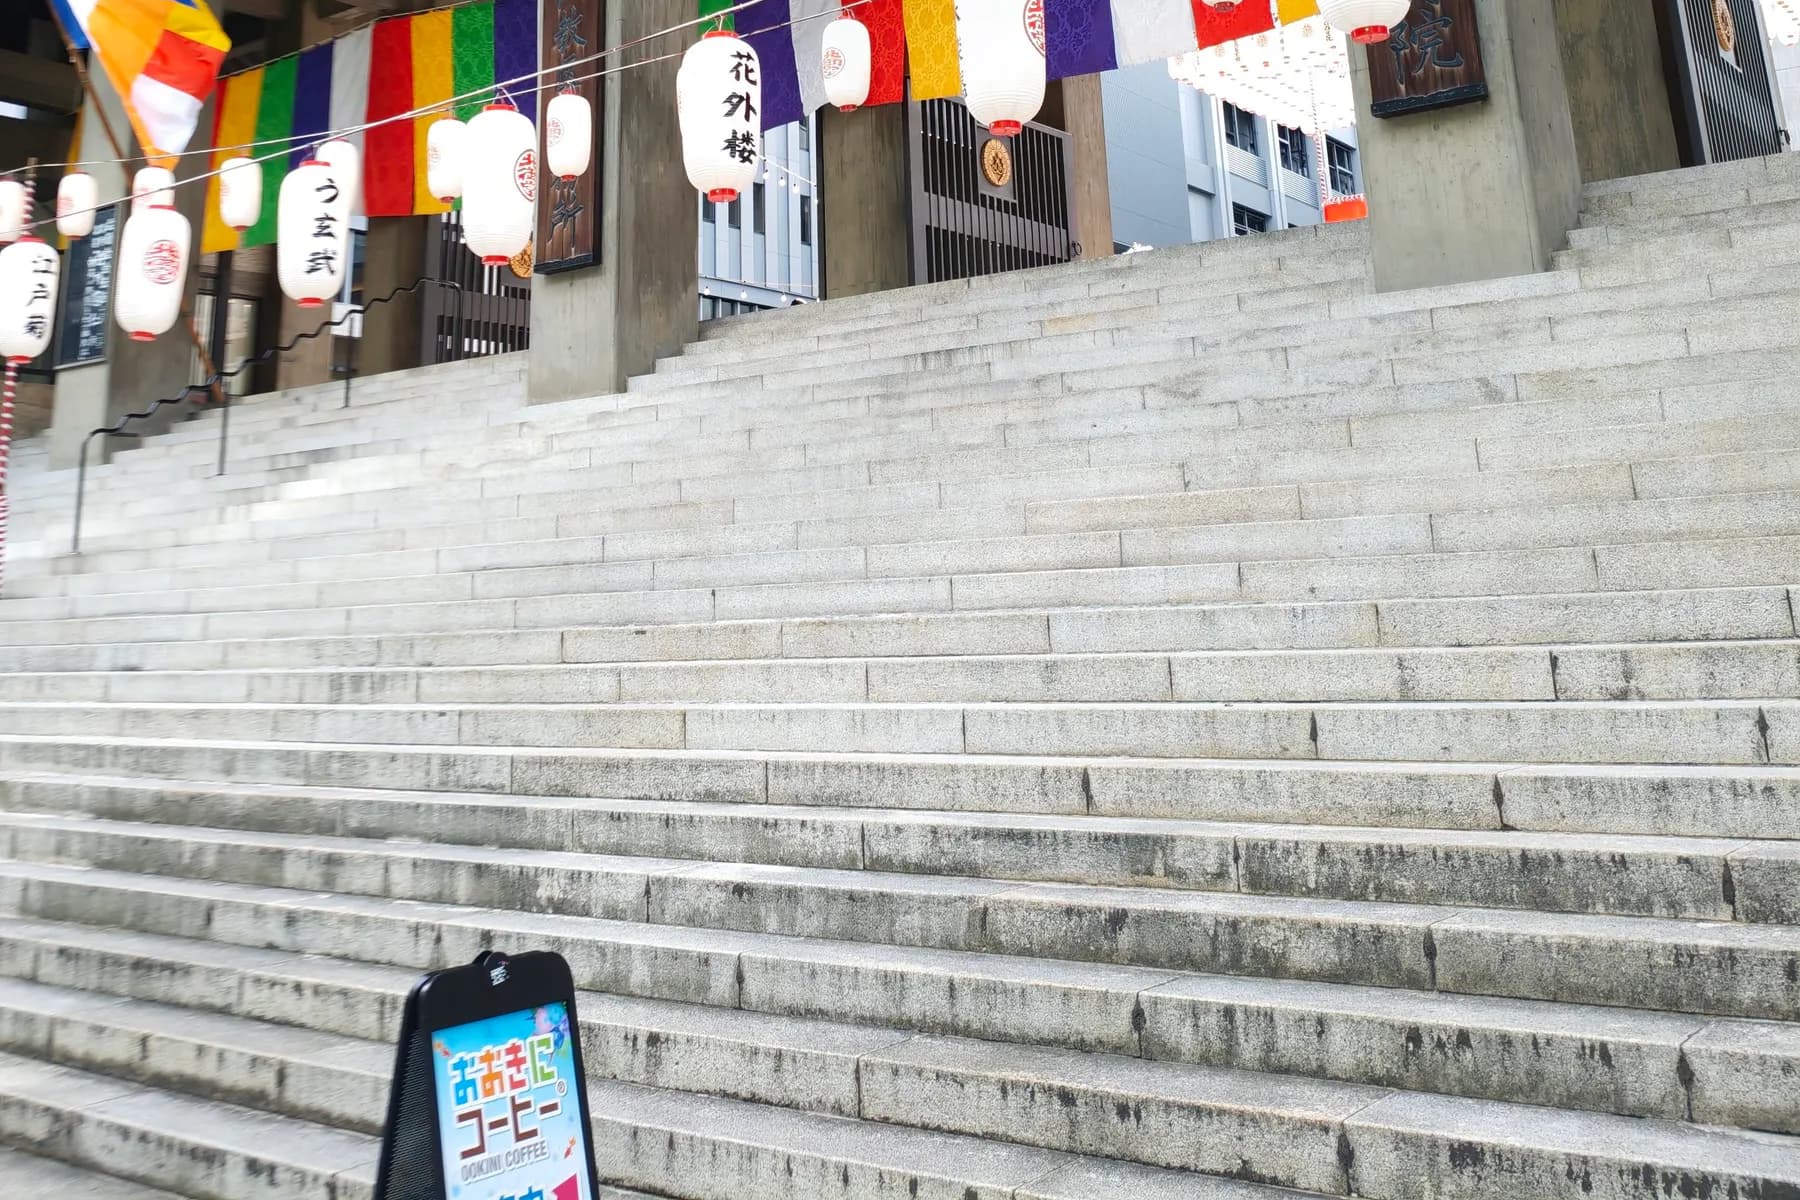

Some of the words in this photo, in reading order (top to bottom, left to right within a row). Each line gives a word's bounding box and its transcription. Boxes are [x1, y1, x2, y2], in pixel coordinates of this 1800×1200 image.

[720, 50, 759, 165] 花外楼
[450, 1035, 556, 1107] おおきに
[455, 1095, 560, 1161] コーヒー
[460, 1154, 502, 1182] OOKINI
[504, 1140, 549, 1168] COFFEE
